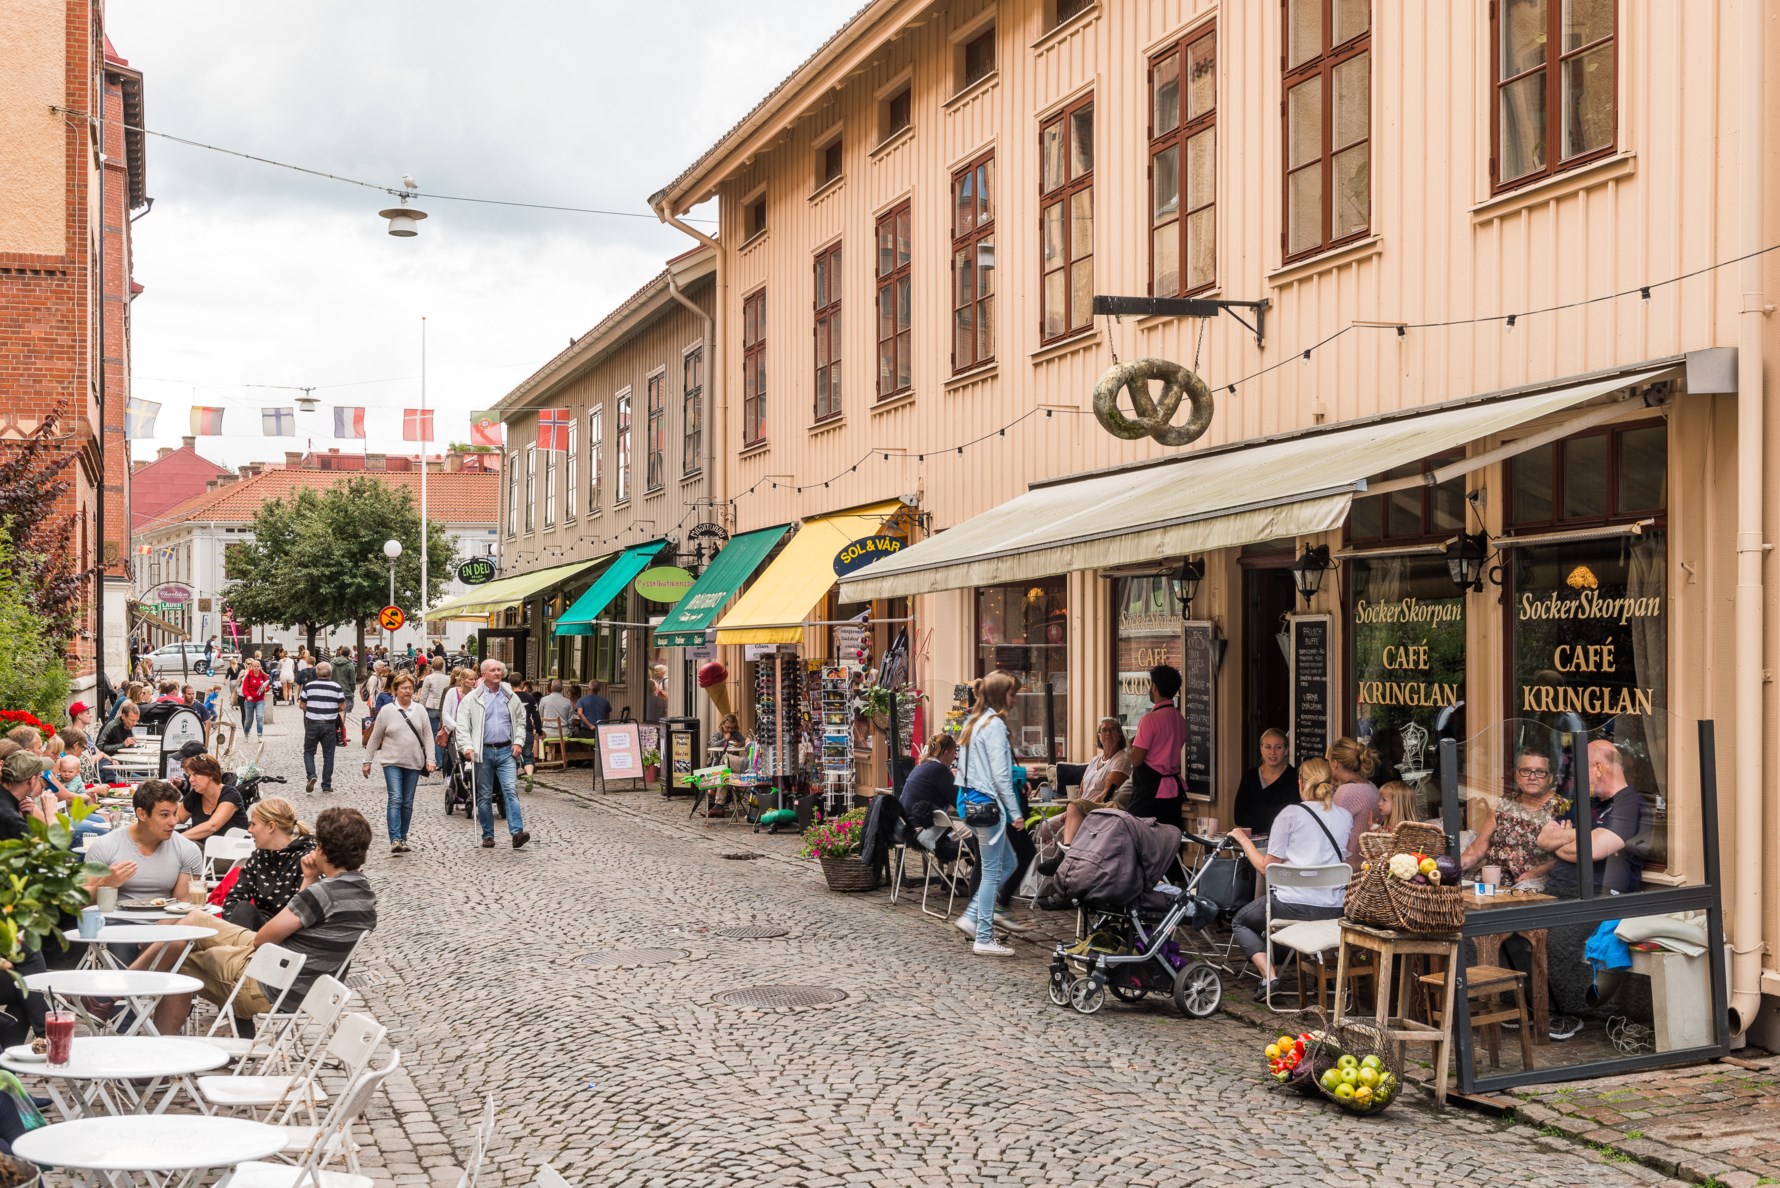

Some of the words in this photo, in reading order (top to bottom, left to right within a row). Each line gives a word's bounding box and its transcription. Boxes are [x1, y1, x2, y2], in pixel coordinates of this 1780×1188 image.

[462, 564, 473, 577] EN
[1355, 598, 1462, 628] SockerSkorpan
[1519, 590, 1661, 626] SockerSkorpan
[1137, 643, 1168, 667] CAFÉ
[1382, 639, 1430, 671] CAFÉ
[1553, 637, 1617, 672] CAFÉ
[1358, 682, 1458, 708] KRINGLAN
[1522, 685, 1654, 717] KRINGLAN
